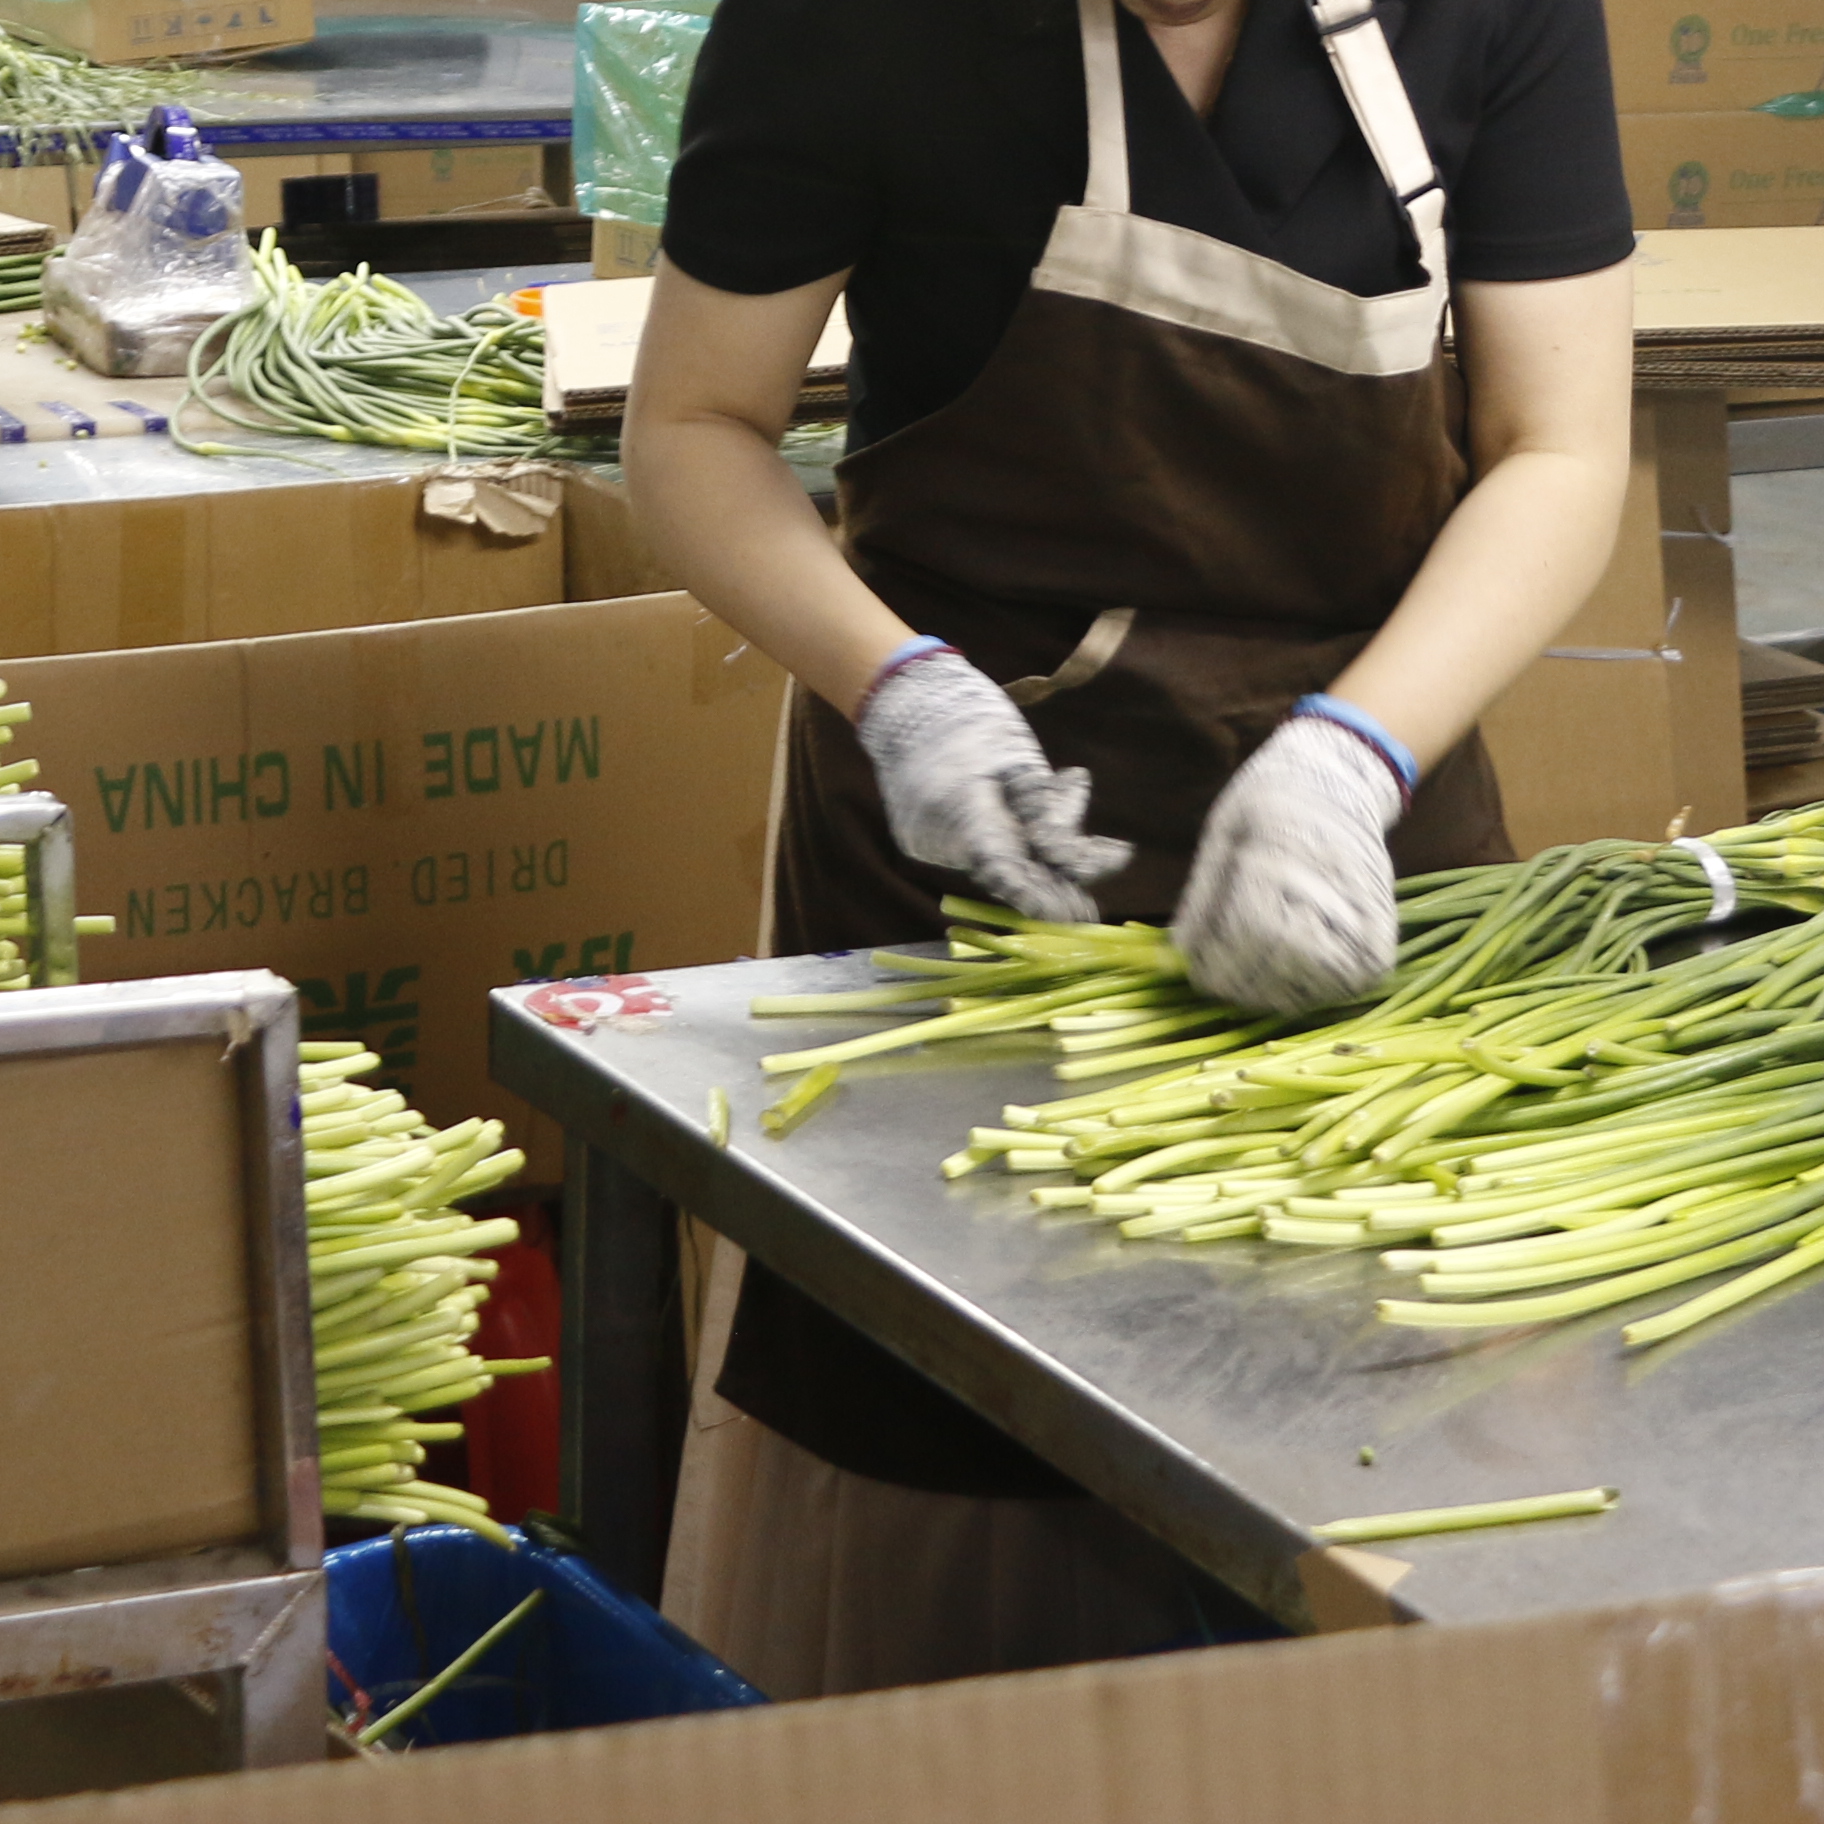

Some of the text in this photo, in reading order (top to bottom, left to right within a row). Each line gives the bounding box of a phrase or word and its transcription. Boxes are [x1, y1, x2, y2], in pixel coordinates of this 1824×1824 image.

[1730, 24, 1774, 46] One
[95, 718, 600, 833] MADE IN CHINA
[127, 866, 370, 938] BRACKEN
